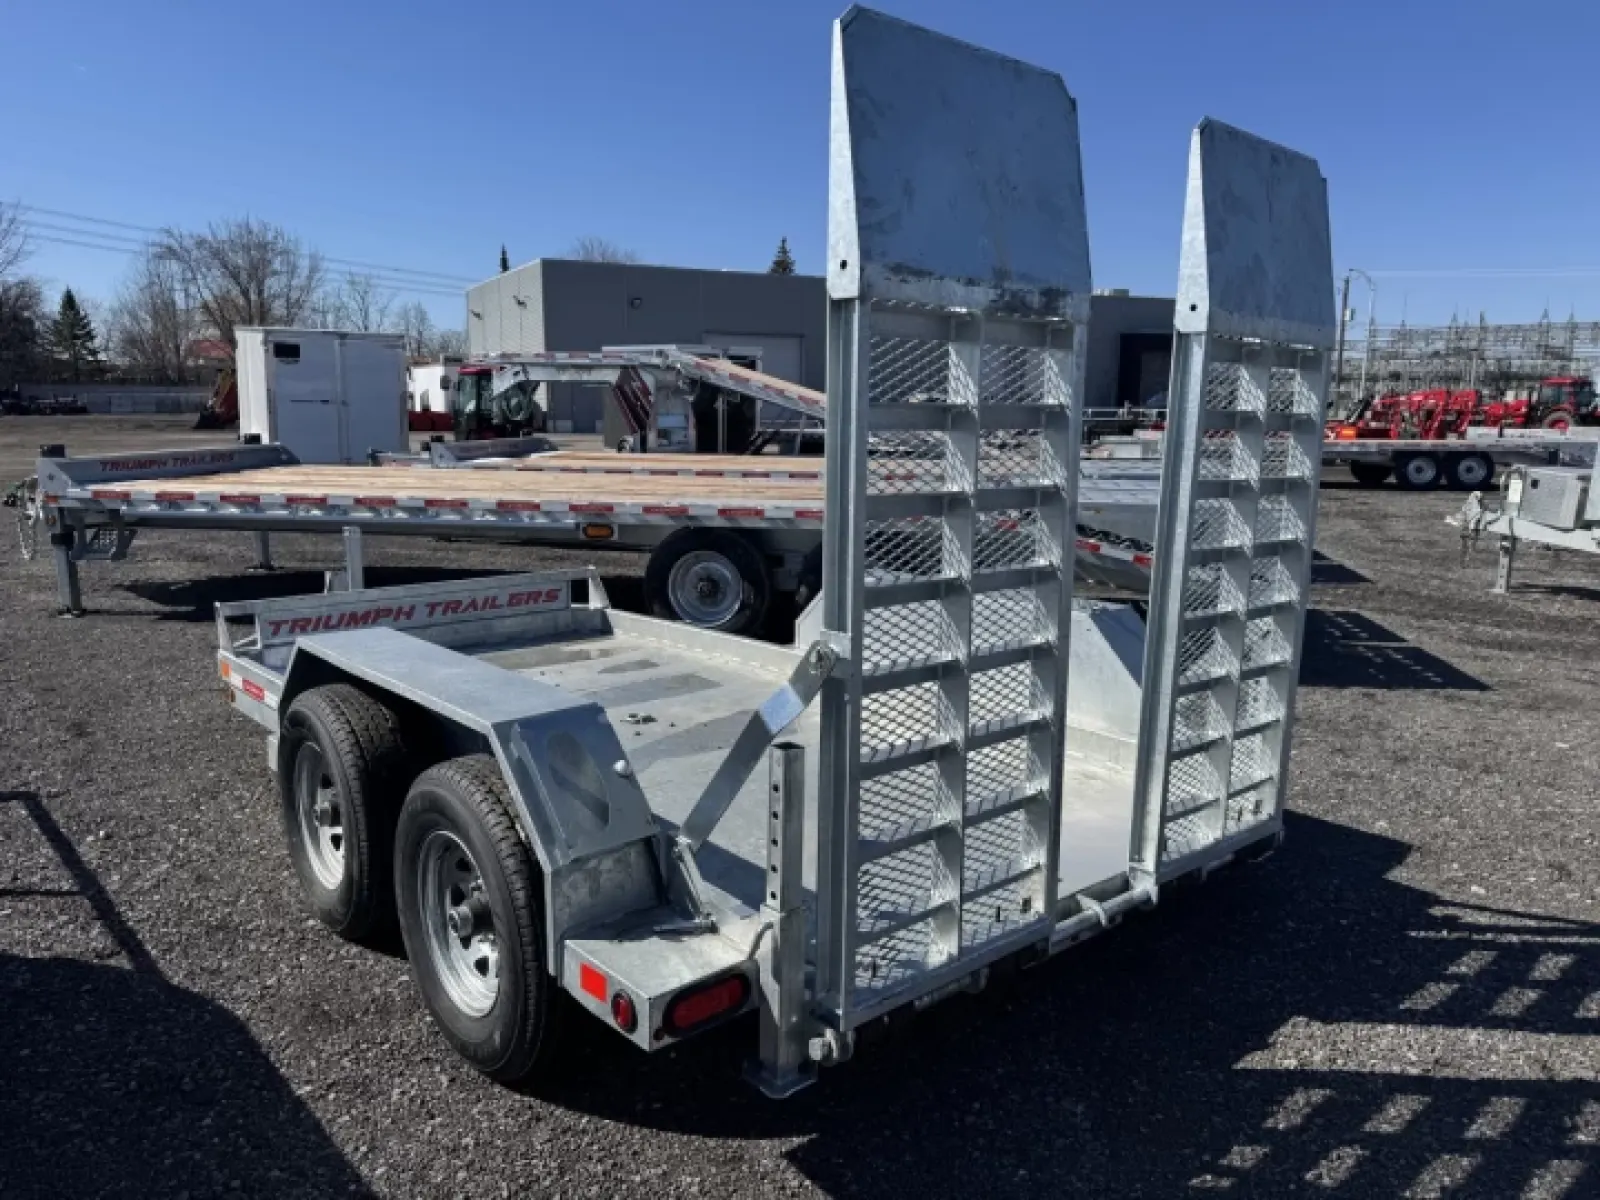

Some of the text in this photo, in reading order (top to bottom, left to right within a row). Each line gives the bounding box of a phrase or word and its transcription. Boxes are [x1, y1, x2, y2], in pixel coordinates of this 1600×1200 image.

[100, 452, 236, 472] TRIUMPH TRAILERS
[268, 588, 562, 637] TRIUMPH TRAILERS
